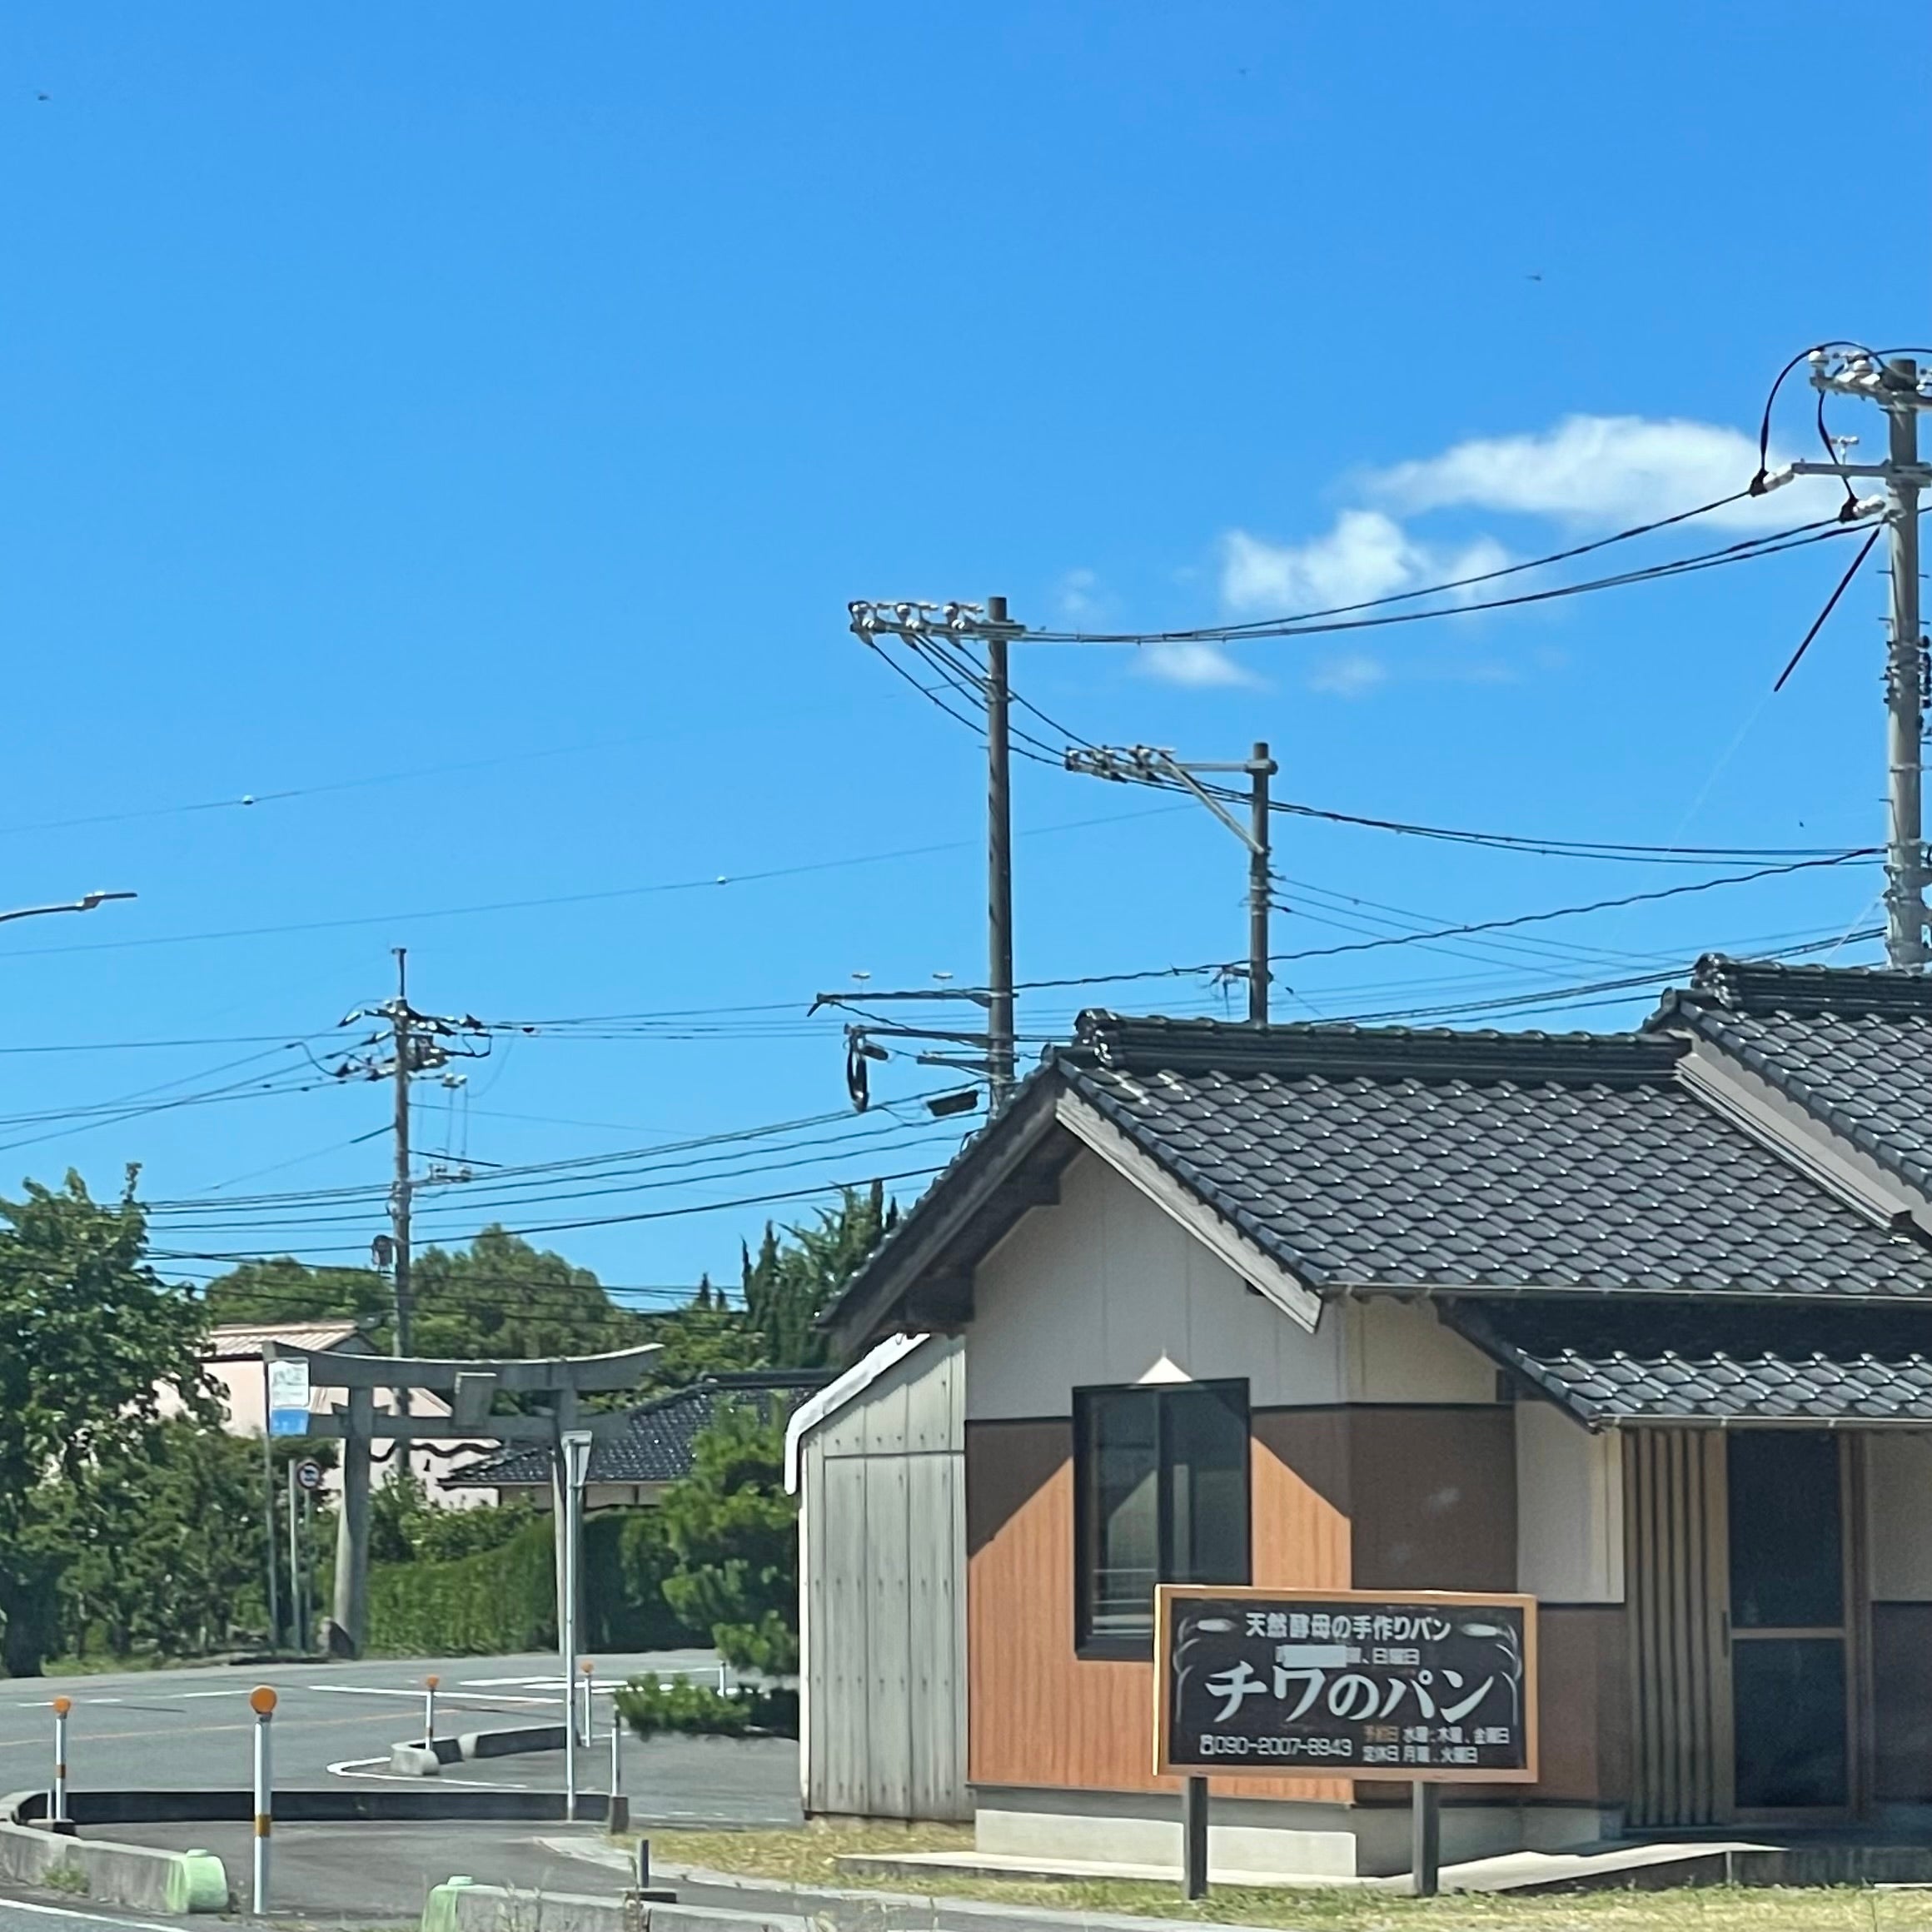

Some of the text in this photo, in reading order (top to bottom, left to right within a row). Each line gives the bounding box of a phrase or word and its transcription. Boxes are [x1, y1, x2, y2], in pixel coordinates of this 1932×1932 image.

[1246, 1612, 1451, 1641] 天然酵母の手作りパン
[1205, 1661, 1494, 1723] チワのパン
